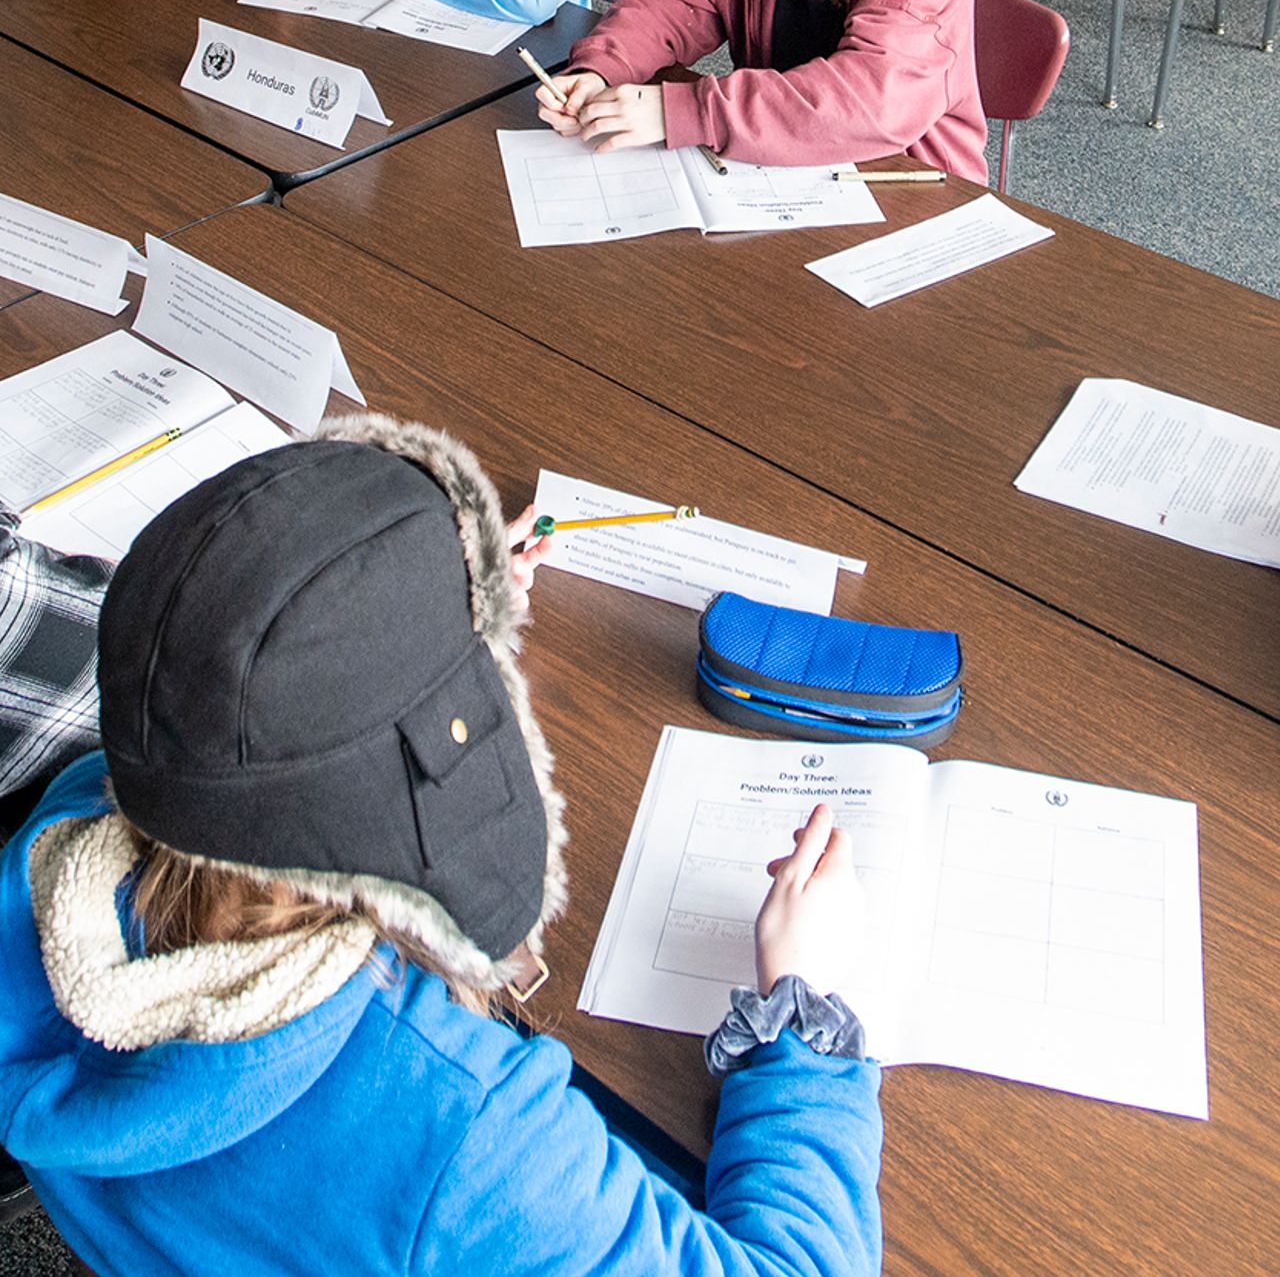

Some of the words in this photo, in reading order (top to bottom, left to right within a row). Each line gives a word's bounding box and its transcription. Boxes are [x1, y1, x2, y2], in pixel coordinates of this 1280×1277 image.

[246, 68, 297, 97] Honduras
[778, 772, 800, 783] Day
[803, 772, 838, 783] Three:
[739, 782, 838, 797] Problem/Solution
[840, 787, 873, 797] Ideas
